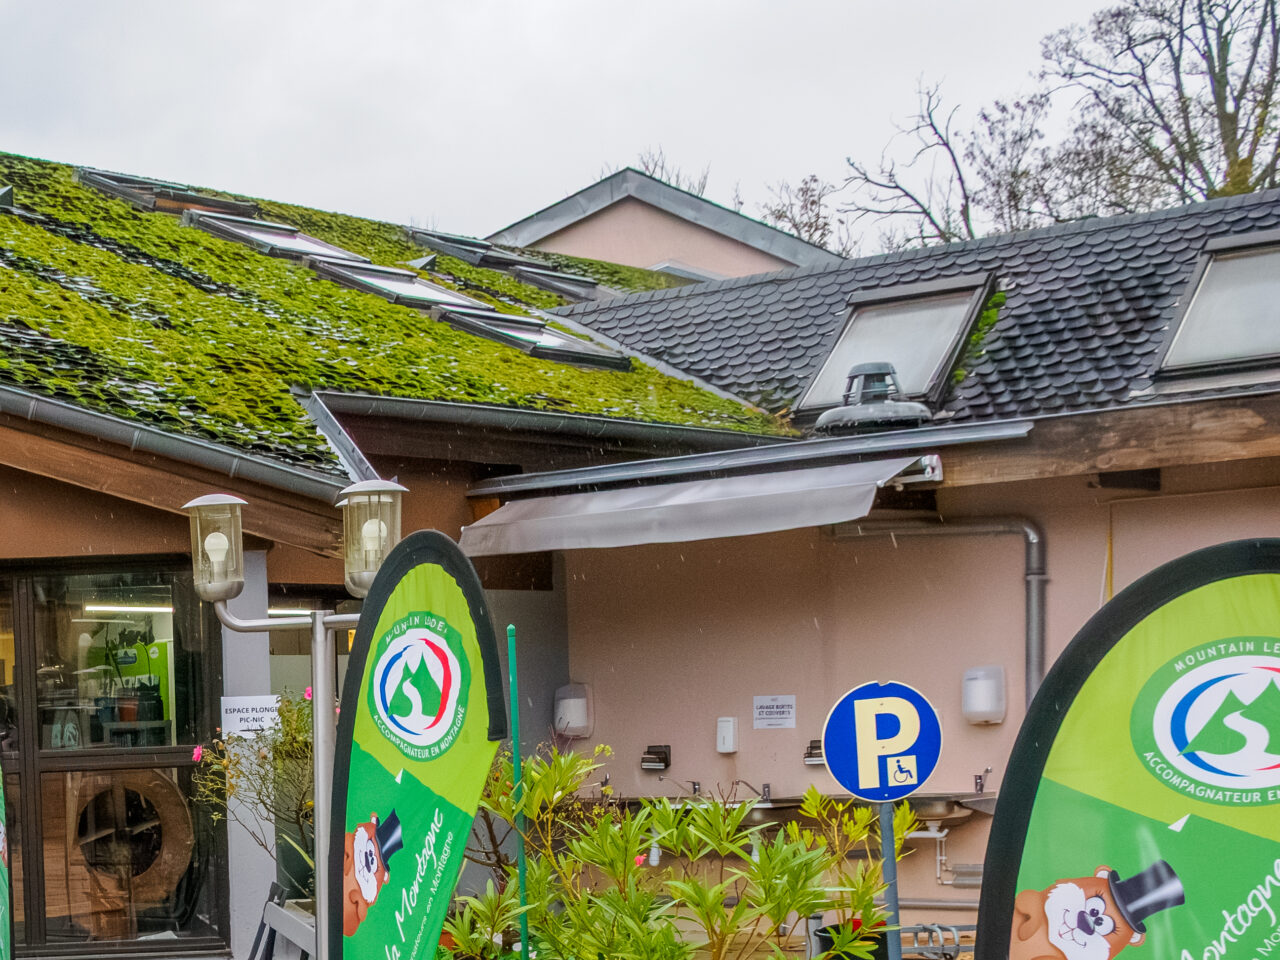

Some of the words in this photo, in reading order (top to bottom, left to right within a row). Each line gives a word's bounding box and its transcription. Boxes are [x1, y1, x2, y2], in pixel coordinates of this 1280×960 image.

[1173, 641, 1255, 673] MOUNTAIN
[373, 714, 430, 759] ACCOMPAGNATEUR
[430, 746, 440, 758] EN
[440, 706, 465, 753] MONTAGNE
[854, 697, 921, 789] P
[1143, 751, 1262, 803] ACCOMPAGNATEUR
[394, 807, 444, 943] Montagne
[430, 831, 454, 896] Montagne
